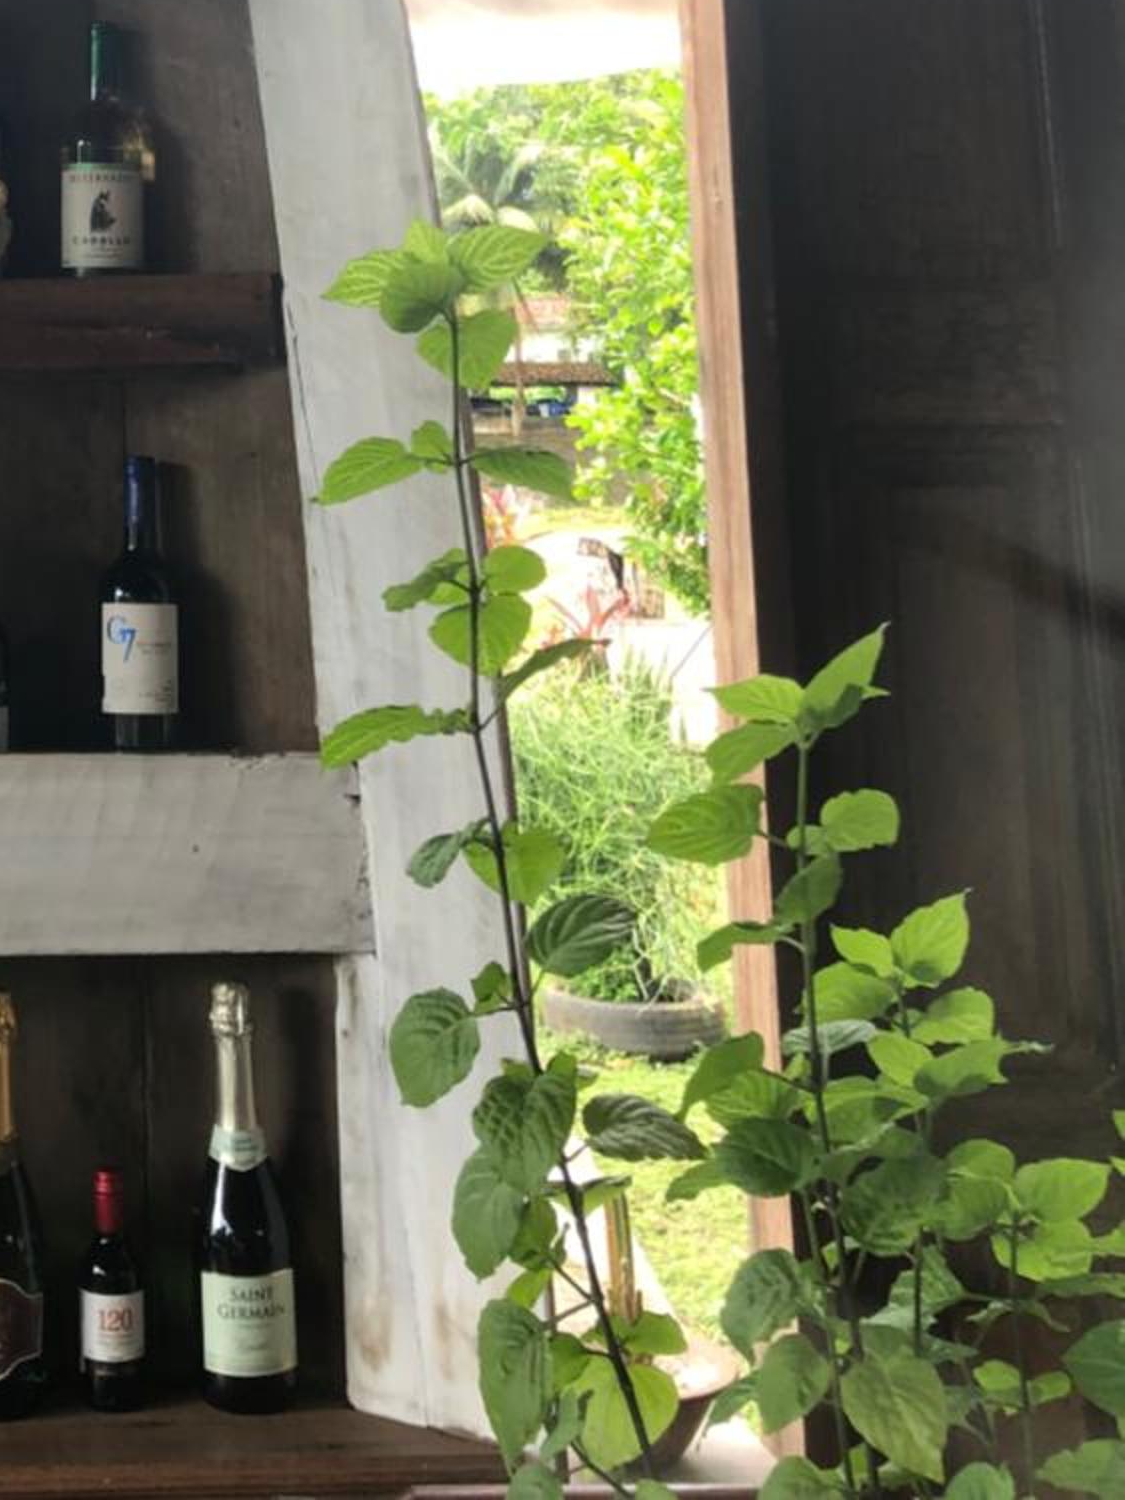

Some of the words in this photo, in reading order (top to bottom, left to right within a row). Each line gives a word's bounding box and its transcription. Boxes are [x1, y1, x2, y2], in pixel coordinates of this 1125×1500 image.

[229, 1285, 273, 1302] SAINT
[98, 1308, 133, 1332] 120
[217, 1301, 285, 1320] GERMAIN
